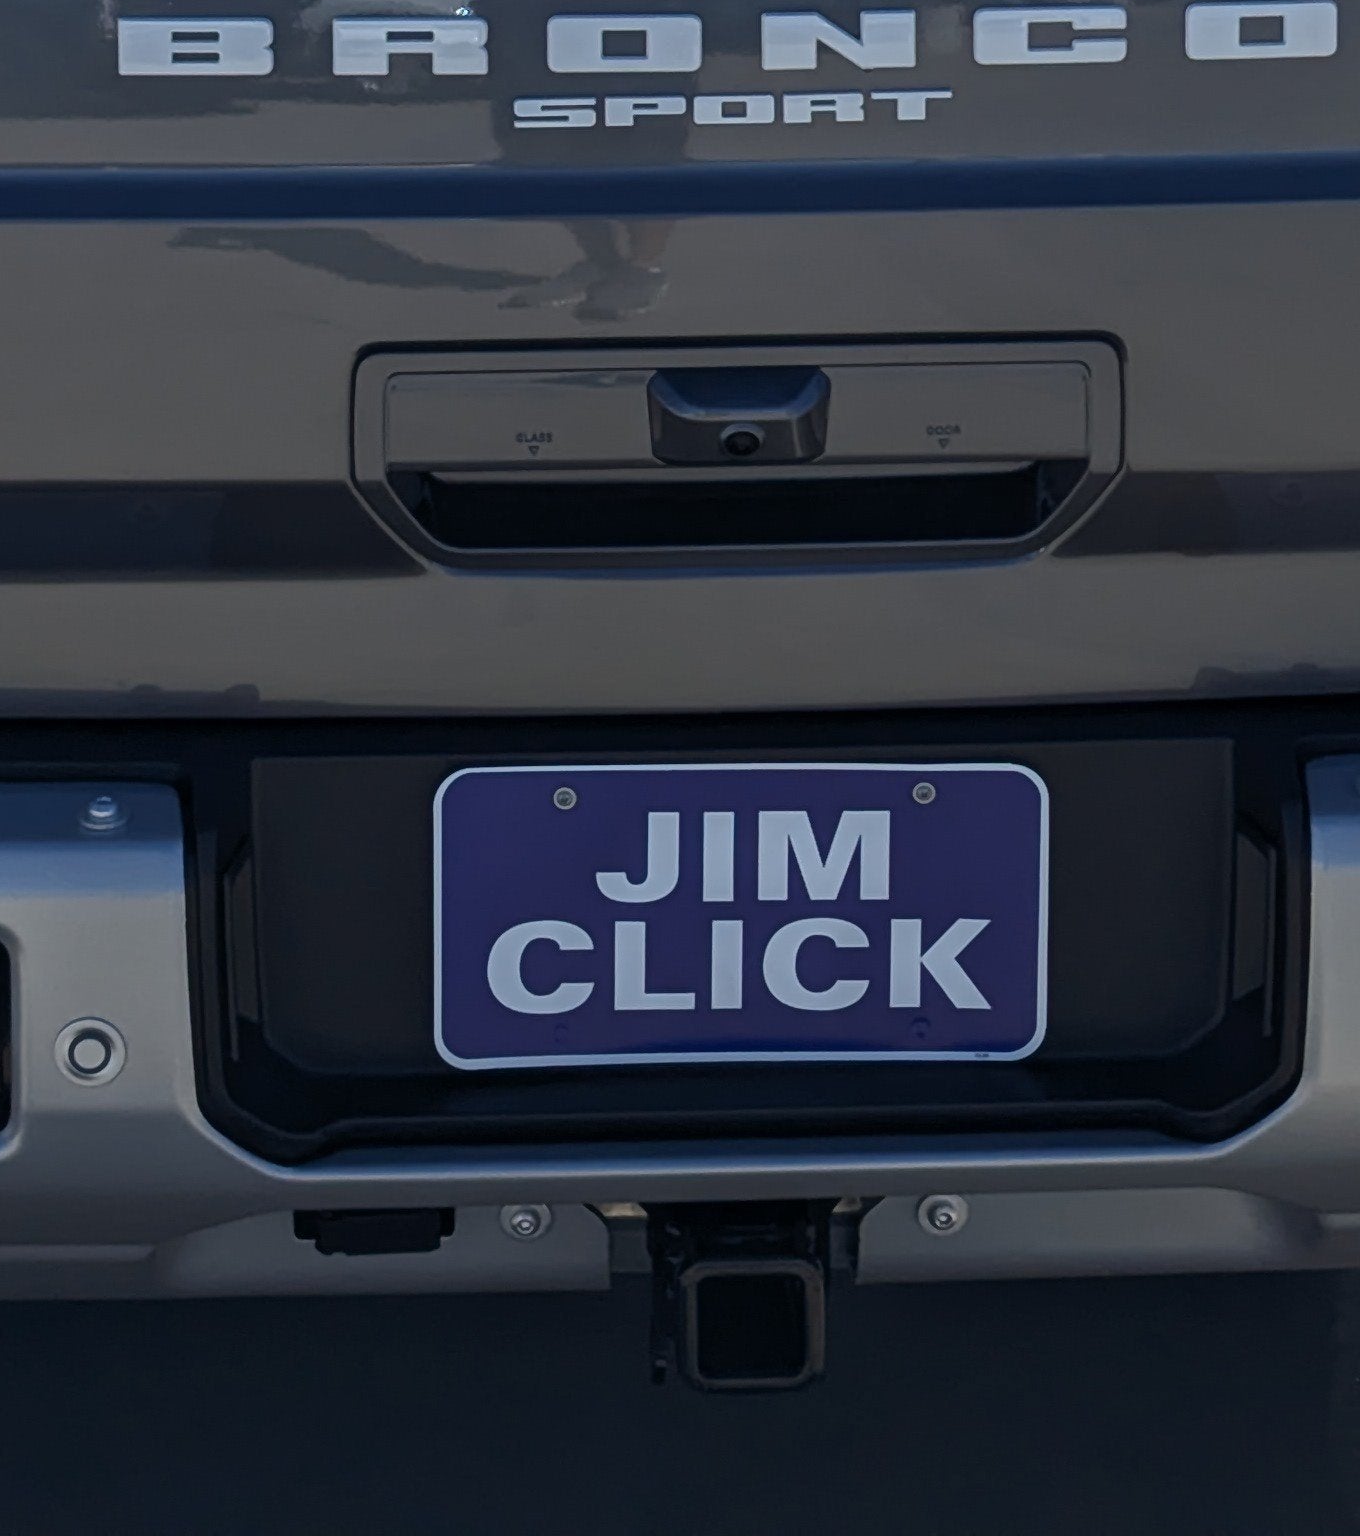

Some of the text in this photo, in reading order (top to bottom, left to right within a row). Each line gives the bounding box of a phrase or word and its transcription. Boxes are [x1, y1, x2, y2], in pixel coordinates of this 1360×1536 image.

[117, 1, 1338, 76] BRONCO
[513, 91, 953, 129] SPORT
[595, 810, 891, 904] JIM
[486, 917, 992, 1015] CLICK
